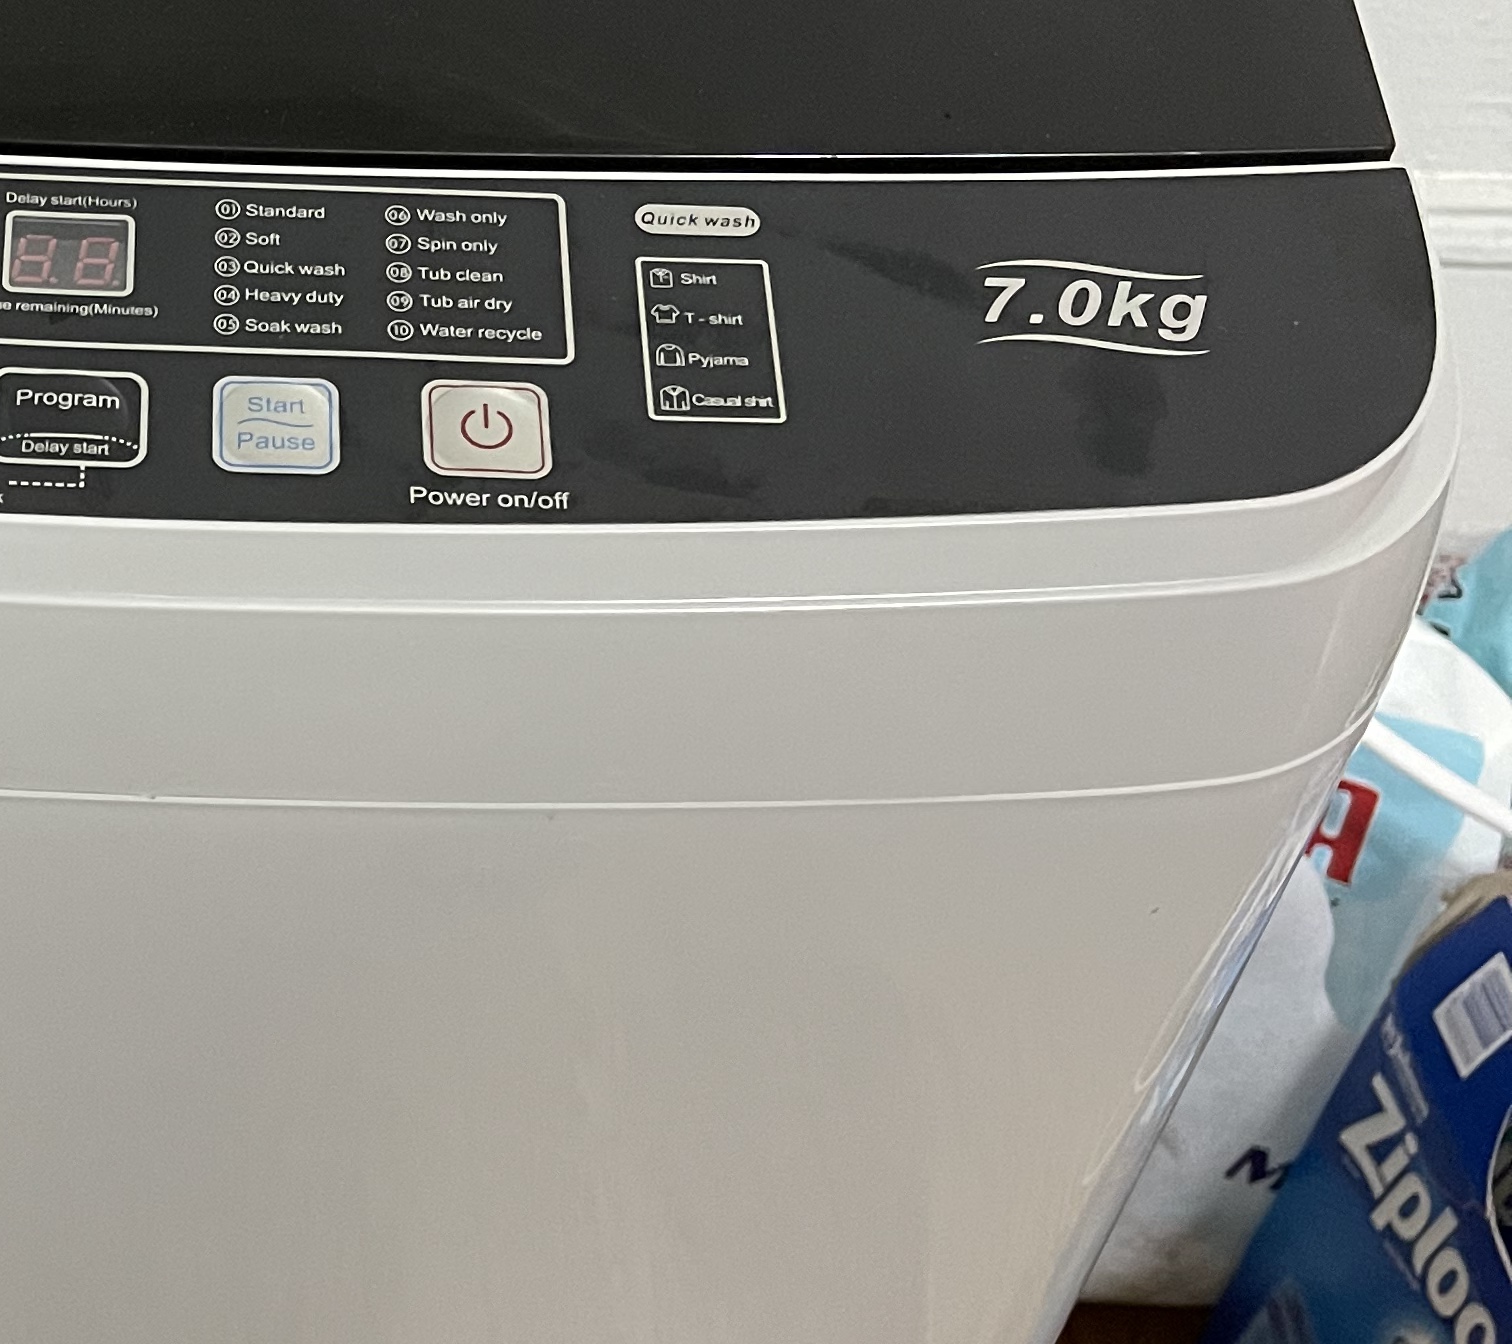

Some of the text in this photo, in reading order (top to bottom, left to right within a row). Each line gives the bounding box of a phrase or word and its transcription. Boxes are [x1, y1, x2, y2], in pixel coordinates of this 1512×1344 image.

[6, 192, 137, 209] Delay start(Hours)
[221, 204, 324, 218] 01 Standard
[389, 209, 507, 226] 06 Wash only
[642, 212, 755, 227] Quick wash
[219, 232, 280, 245] 02 Soft
[389, 237, 497, 255] 07 Spin only
[219, 261, 345, 275] 03 Quick wash
[391, 267, 503, 282] 08 Tub clean
[681, 273, 717, 284] Shirt
[219, 288, 343, 306] 04 Heavy duty
[391, 294, 512, 313] 09 Tub air dry
[16, 302, 158, 318] remaining(Minutes)
[980, 277, 1207, 345] 7.0kg
[218, 318, 342, 334] 05 Soak wash
[684, 312, 694, 323] T
[709, 314, 743, 325] shirt
[393, 324, 542, 342] 10 Water recycle
[689, 353, 748, 367] Pyjama
[17, 389, 119, 409] Program
[248, 397, 304, 414] Start
[692, 394, 773, 407] Casual shirt
[22, 440, 109, 455] Delay start
[238, 432, 315, 450] Pause
[410, 486, 569, 509] Power on/off
